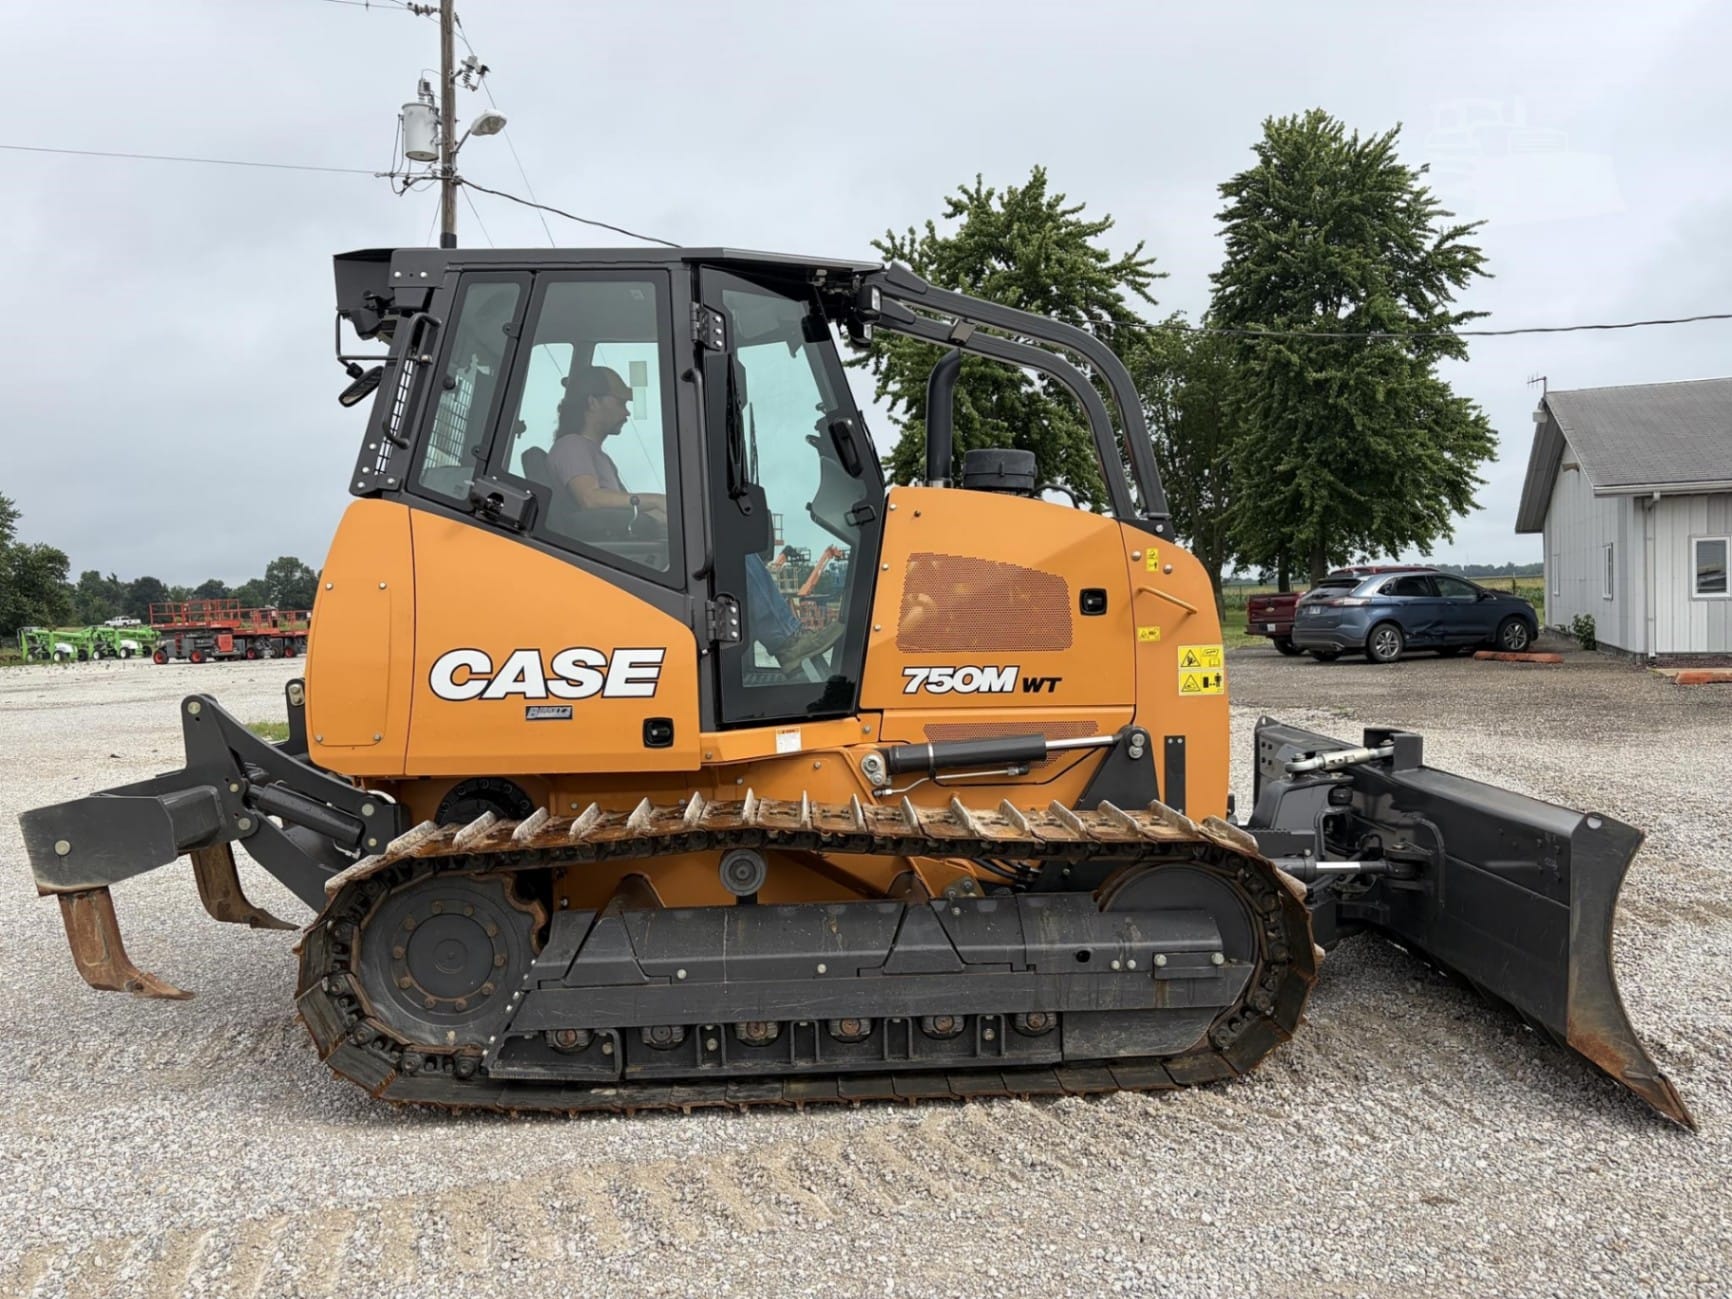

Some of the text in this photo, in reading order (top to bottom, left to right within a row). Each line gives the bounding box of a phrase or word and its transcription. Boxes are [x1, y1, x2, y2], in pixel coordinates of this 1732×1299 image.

[429, 647, 666, 701] CASE
[902, 665, 1062, 694] 750M WT
